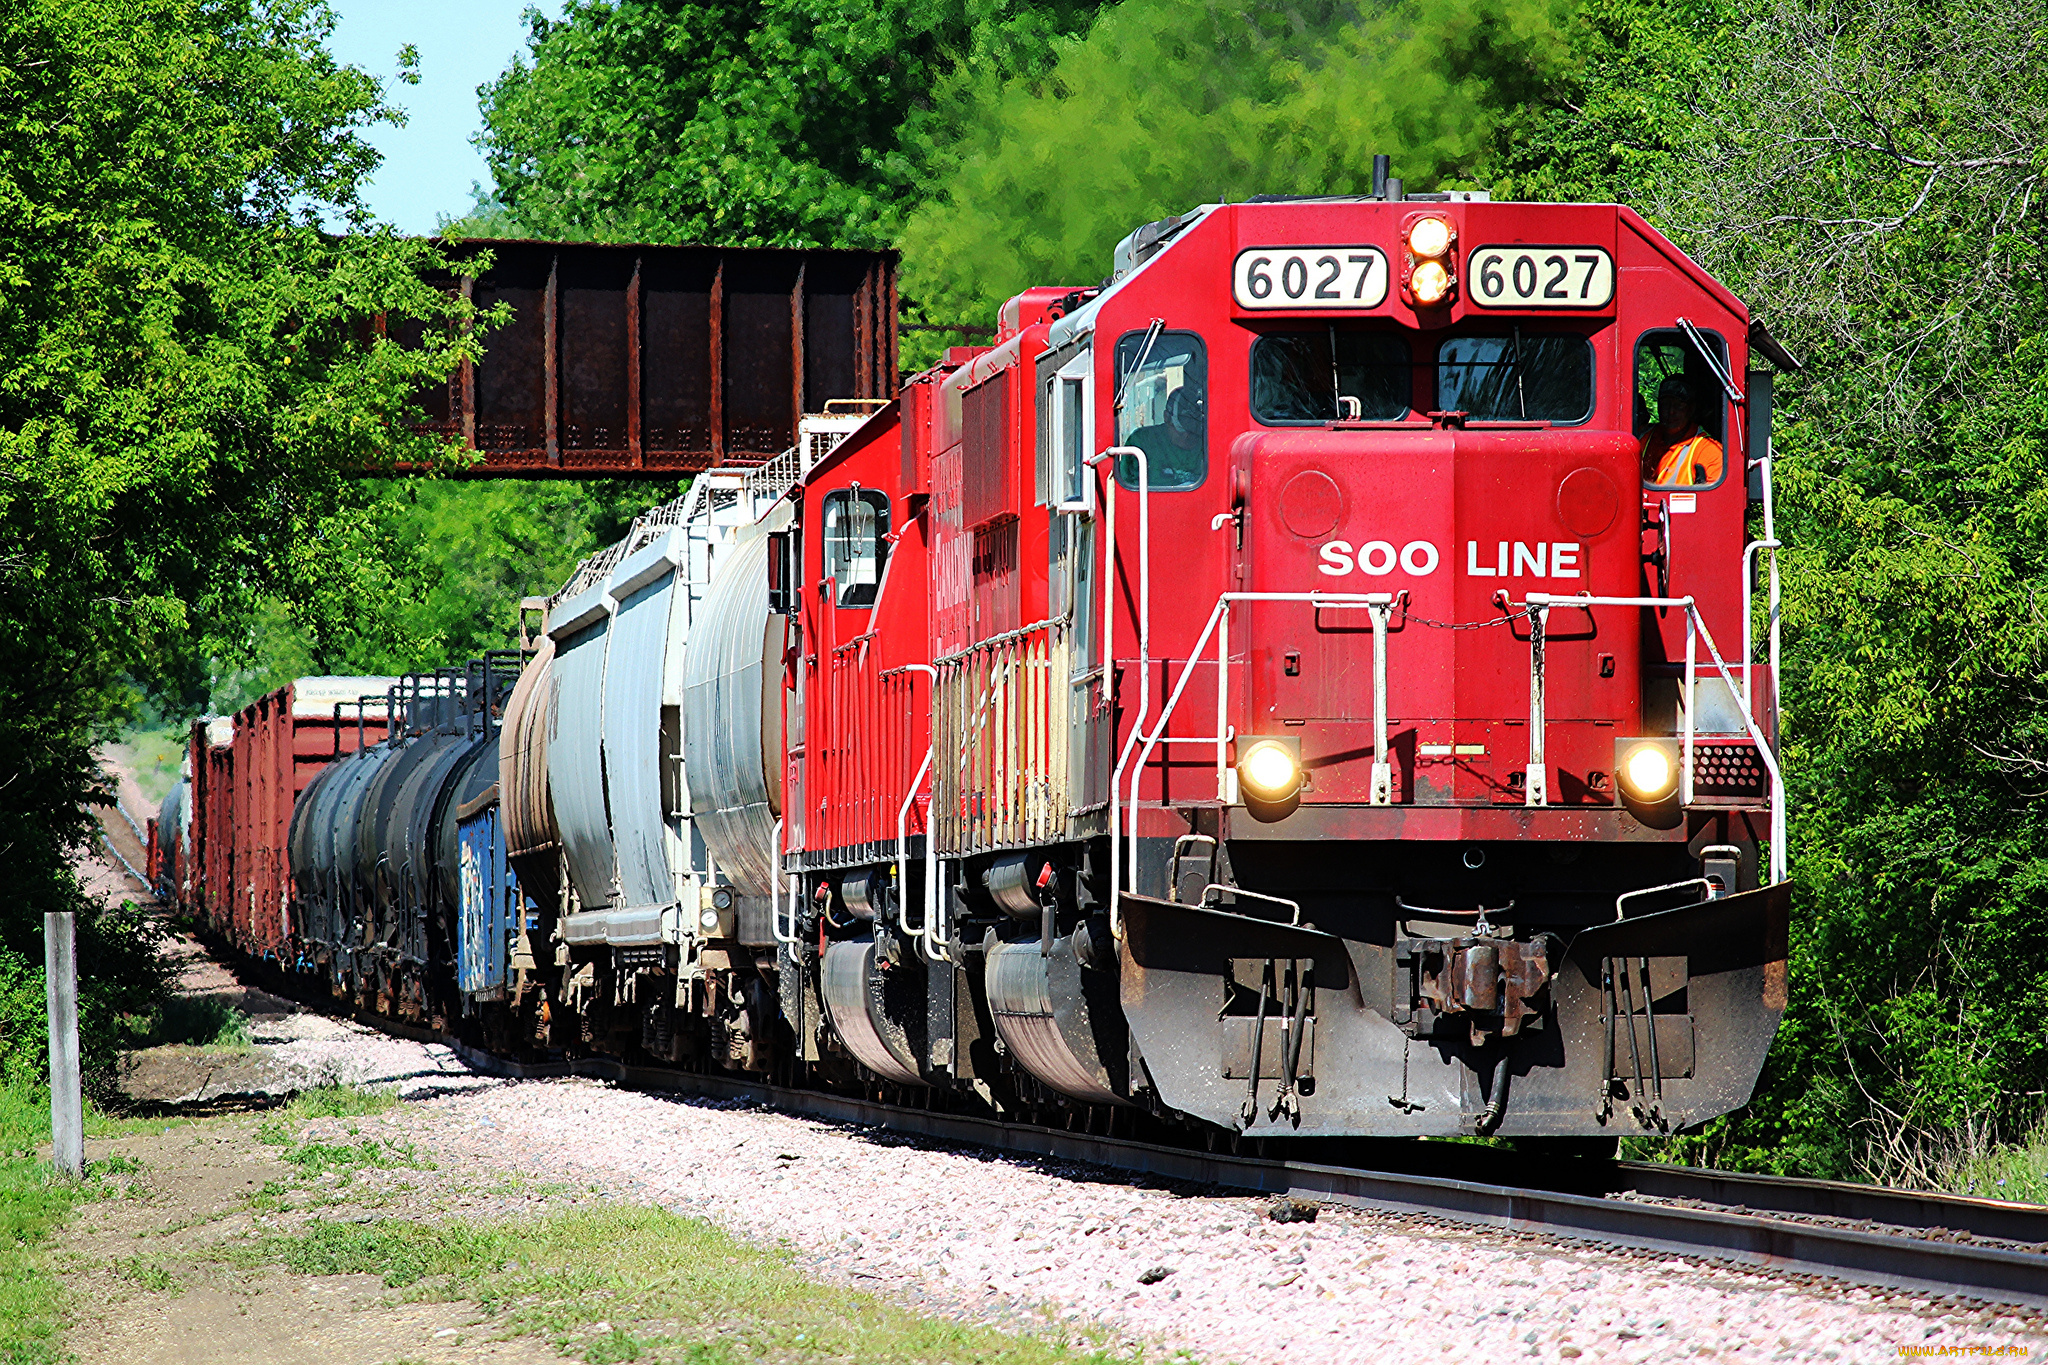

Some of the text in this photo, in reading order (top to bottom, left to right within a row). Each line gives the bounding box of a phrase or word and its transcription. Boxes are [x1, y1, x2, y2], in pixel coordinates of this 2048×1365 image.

[1246, 253, 1376, 300] 6027
[1478, 254, 1600, 299] 6027
[1317, 539, 1581, 578] SOO LINE
